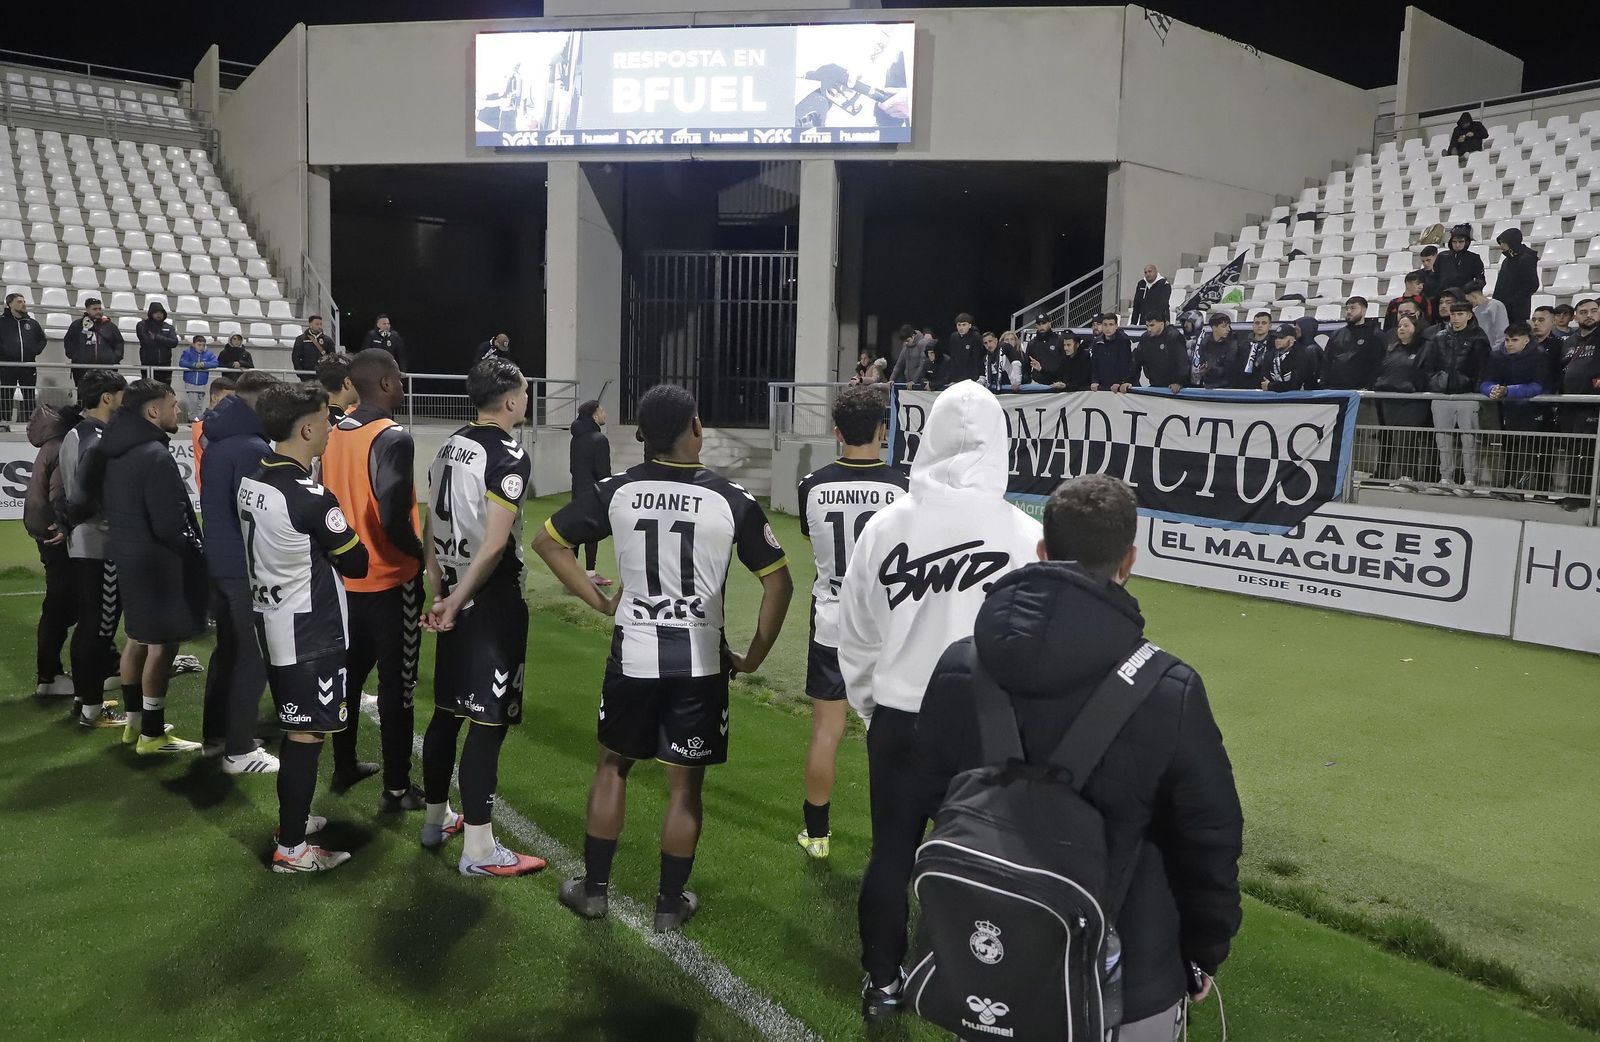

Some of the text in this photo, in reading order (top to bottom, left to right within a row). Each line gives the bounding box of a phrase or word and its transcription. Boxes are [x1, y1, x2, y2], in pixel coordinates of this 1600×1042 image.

[613, 49, 766, 69] RESPOSTA EN
[612, 76, 768, 113] BFUEL
[902, 404, 1325, 505] BNADICTOS
[435, 465, 453, 533] 4
[631, 493, 702, 513] JOANET
[818, 491, 879, 505] JUANIYO
[241, 509, 257, 579] 7
[633, 519, 696, 597] 11
[1161, 530, 1451, 588] EL MALAGUEÑO
[1238, 574, 1342, 598] DESDE 1946
[1526, 547, 1600, 592] Ho
[338, 667, 348, 698] 7
[671, 742, 688, 756] Ruiz
[962, 1018, 1014, 1037] hummel
